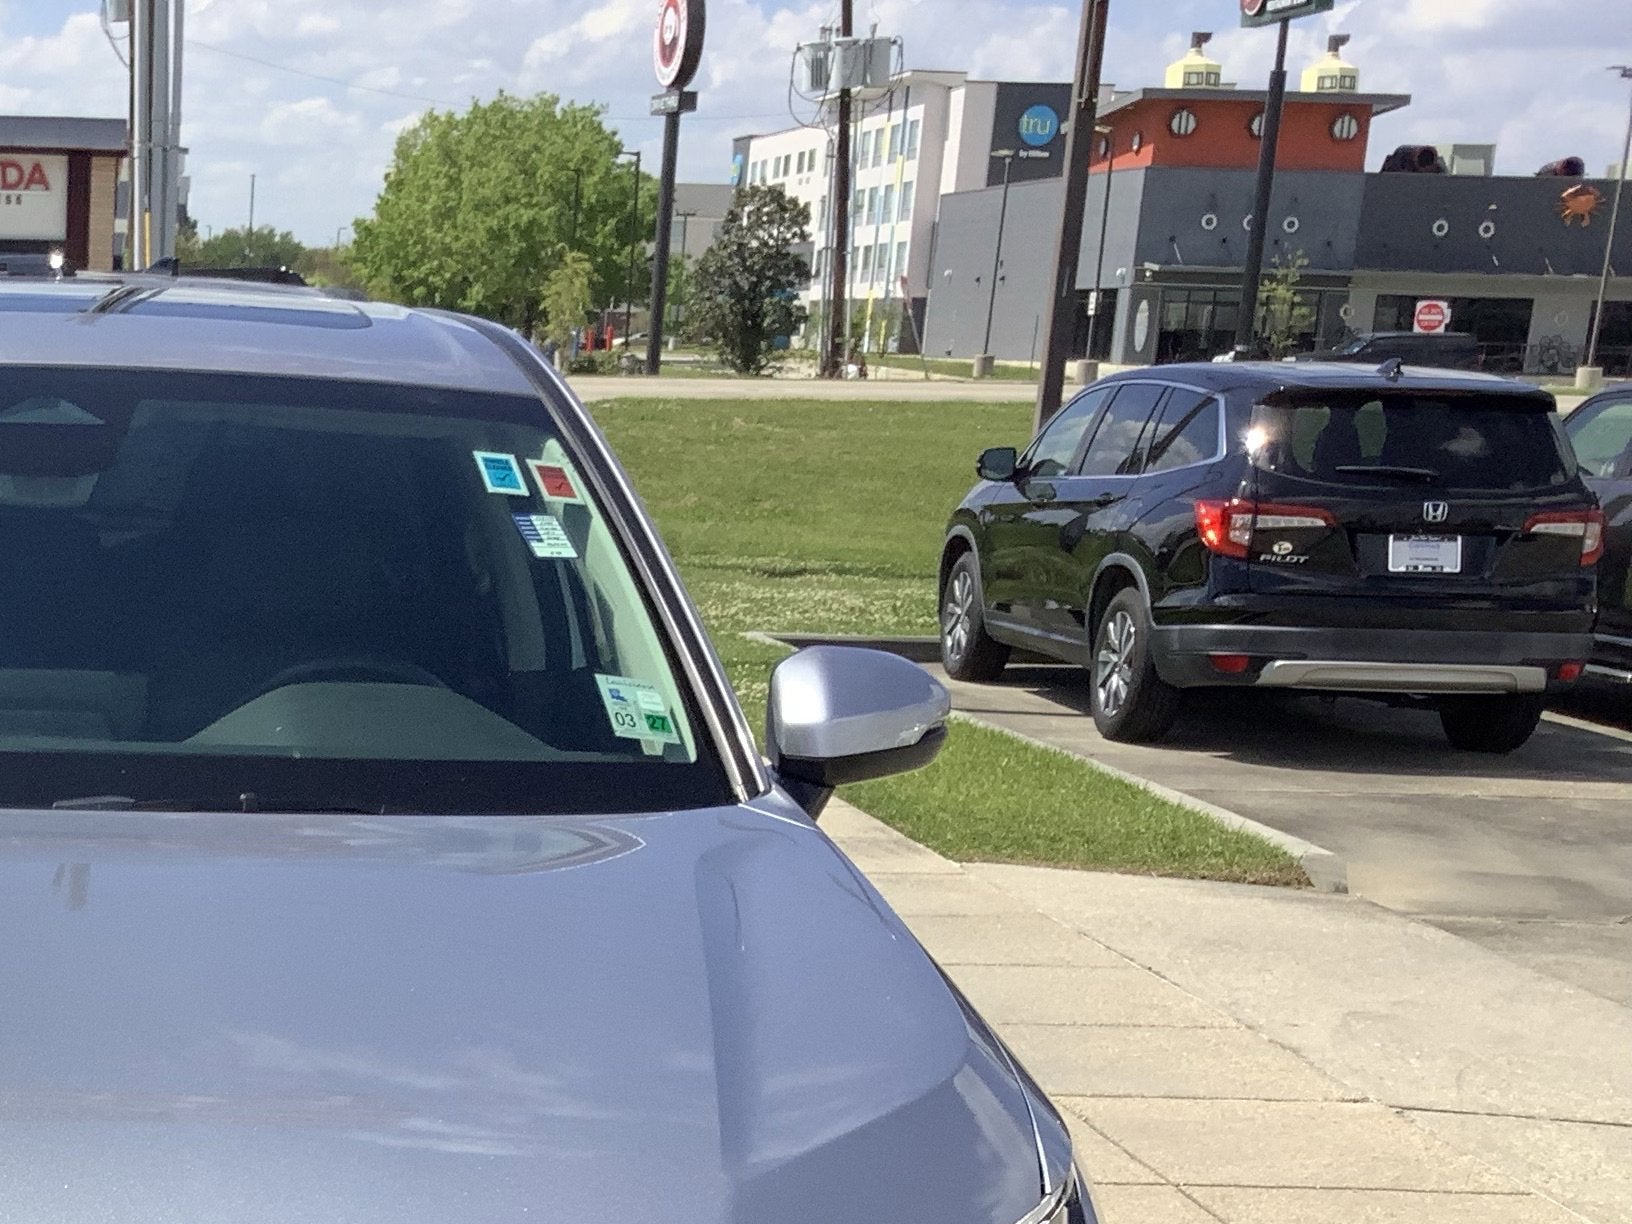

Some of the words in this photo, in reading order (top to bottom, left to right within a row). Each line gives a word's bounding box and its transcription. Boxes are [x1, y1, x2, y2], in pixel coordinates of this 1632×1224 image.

[1022, 114, 1051, 135] tru
[1259, 554, 1310, 563] PILOT
[615, 712, 636, 728] 03
[648, 714, 668, 731] 27
